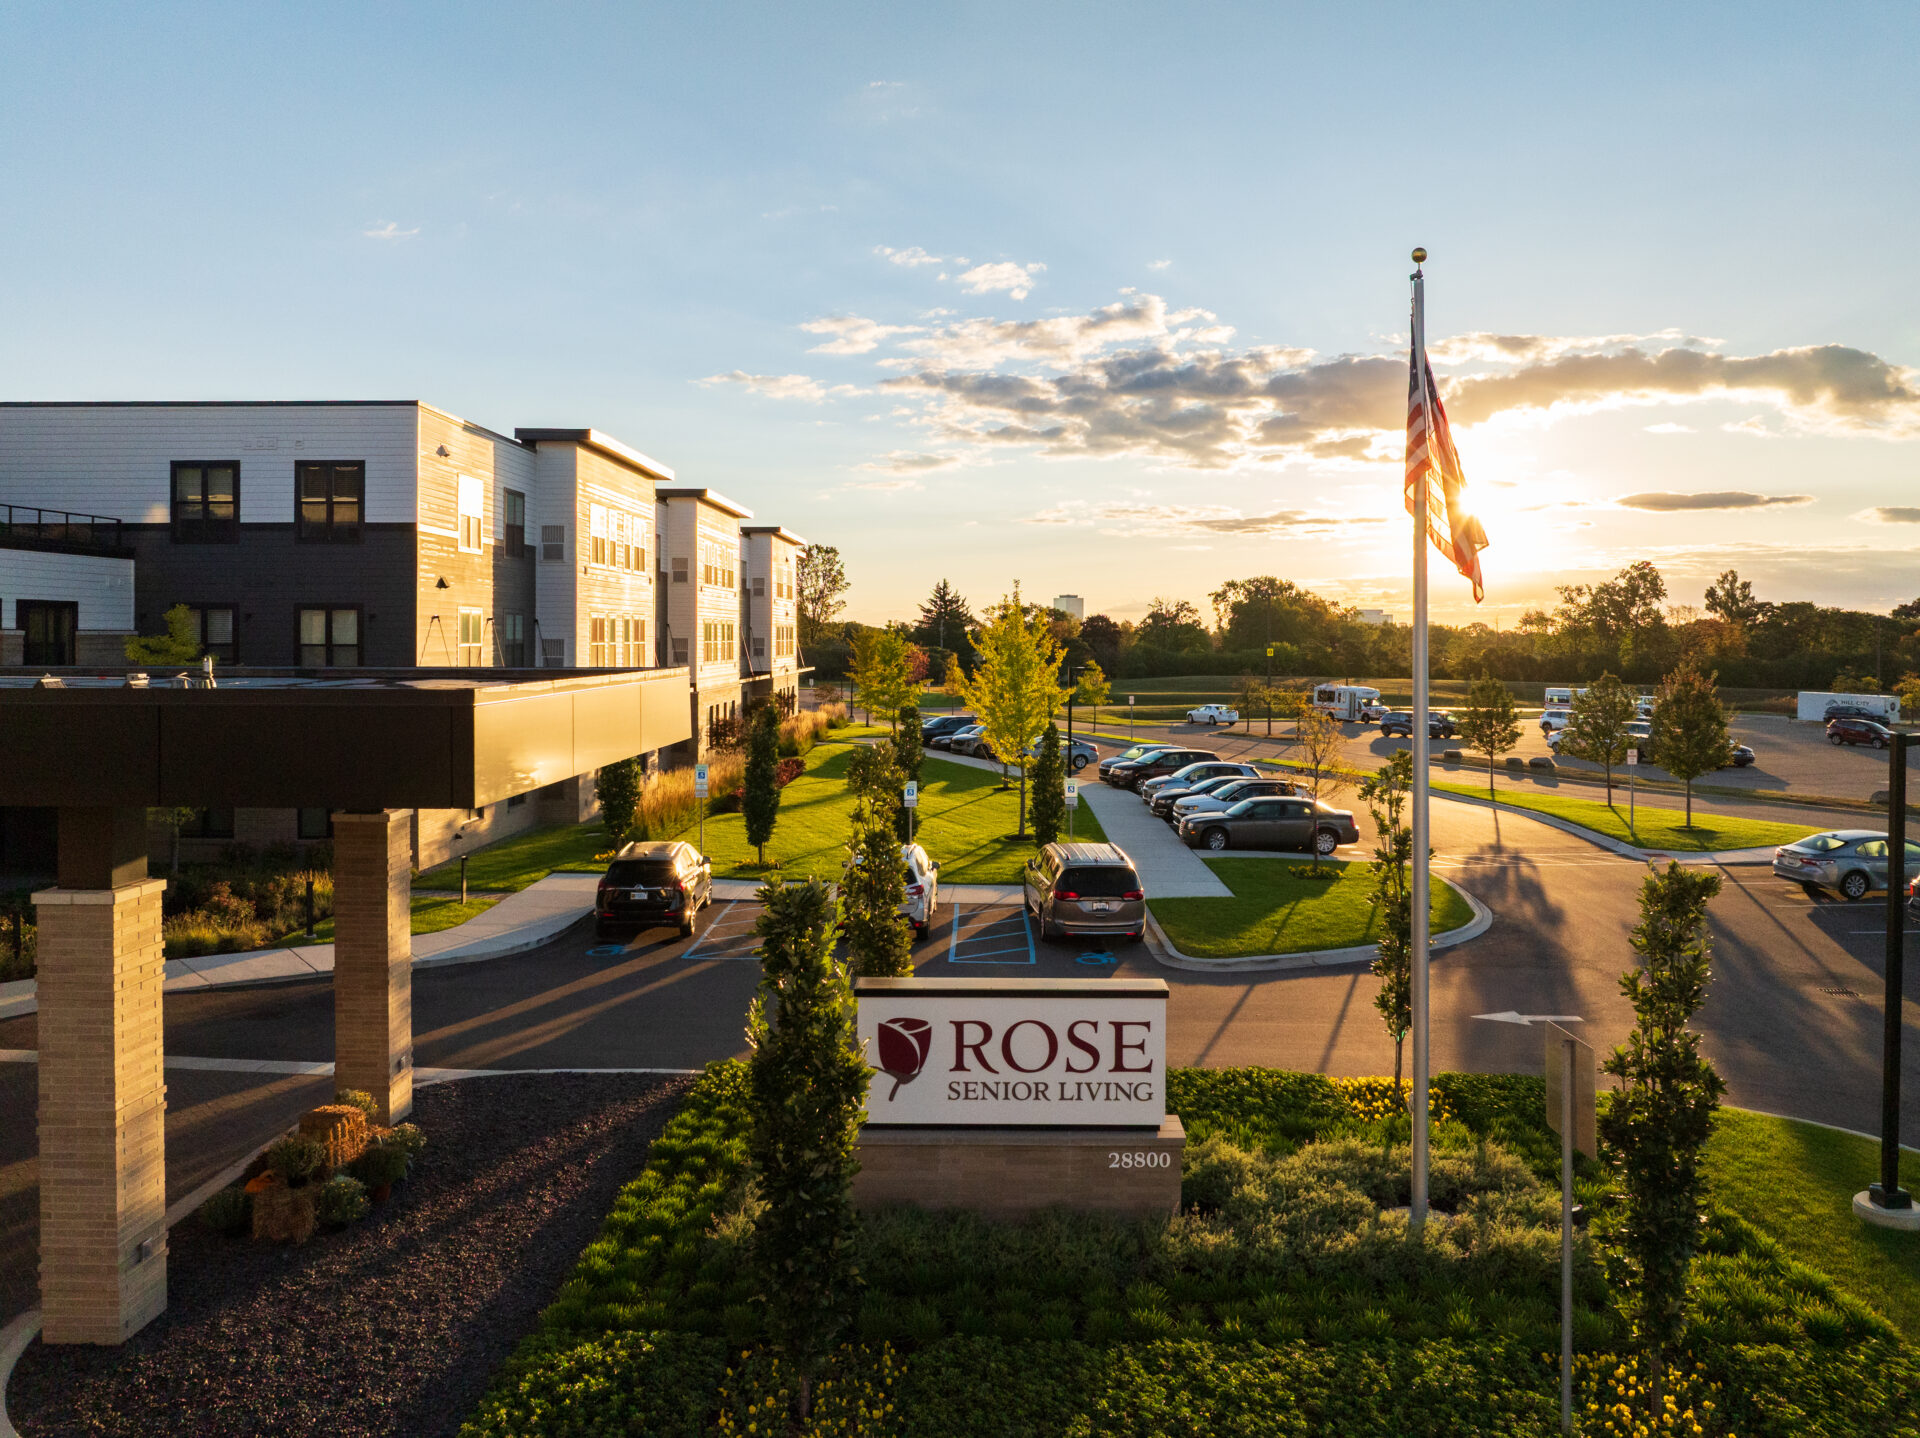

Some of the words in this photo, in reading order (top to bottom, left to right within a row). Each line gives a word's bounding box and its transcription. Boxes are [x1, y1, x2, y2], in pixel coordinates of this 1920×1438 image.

[949, 1020, 1153, 1074] ROSE
[948, 1081, 1051, 1101] SENIOR
[1058, 1082, 1154, 1101] LIVING
[1108, 1152, 1171, 1168] 28800
